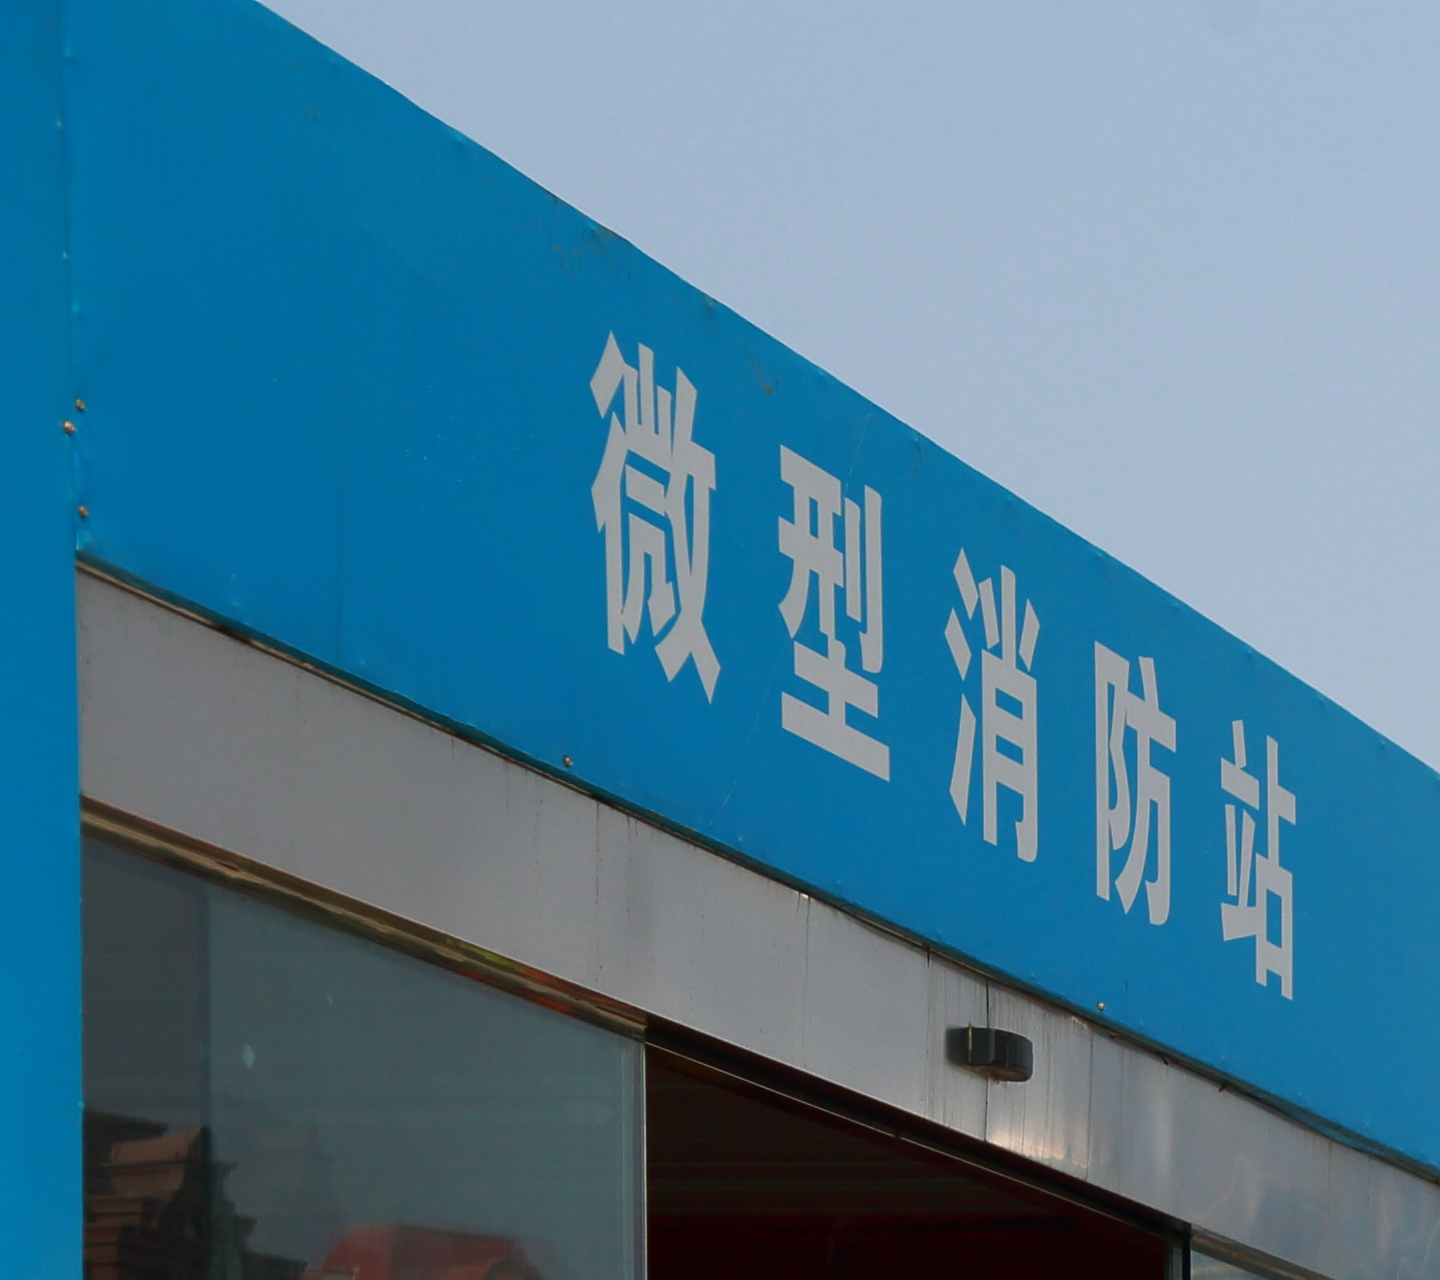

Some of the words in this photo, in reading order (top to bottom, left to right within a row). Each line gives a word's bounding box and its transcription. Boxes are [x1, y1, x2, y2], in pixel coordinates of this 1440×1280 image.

[590, 331, 1297, 1001] 微型消防站
